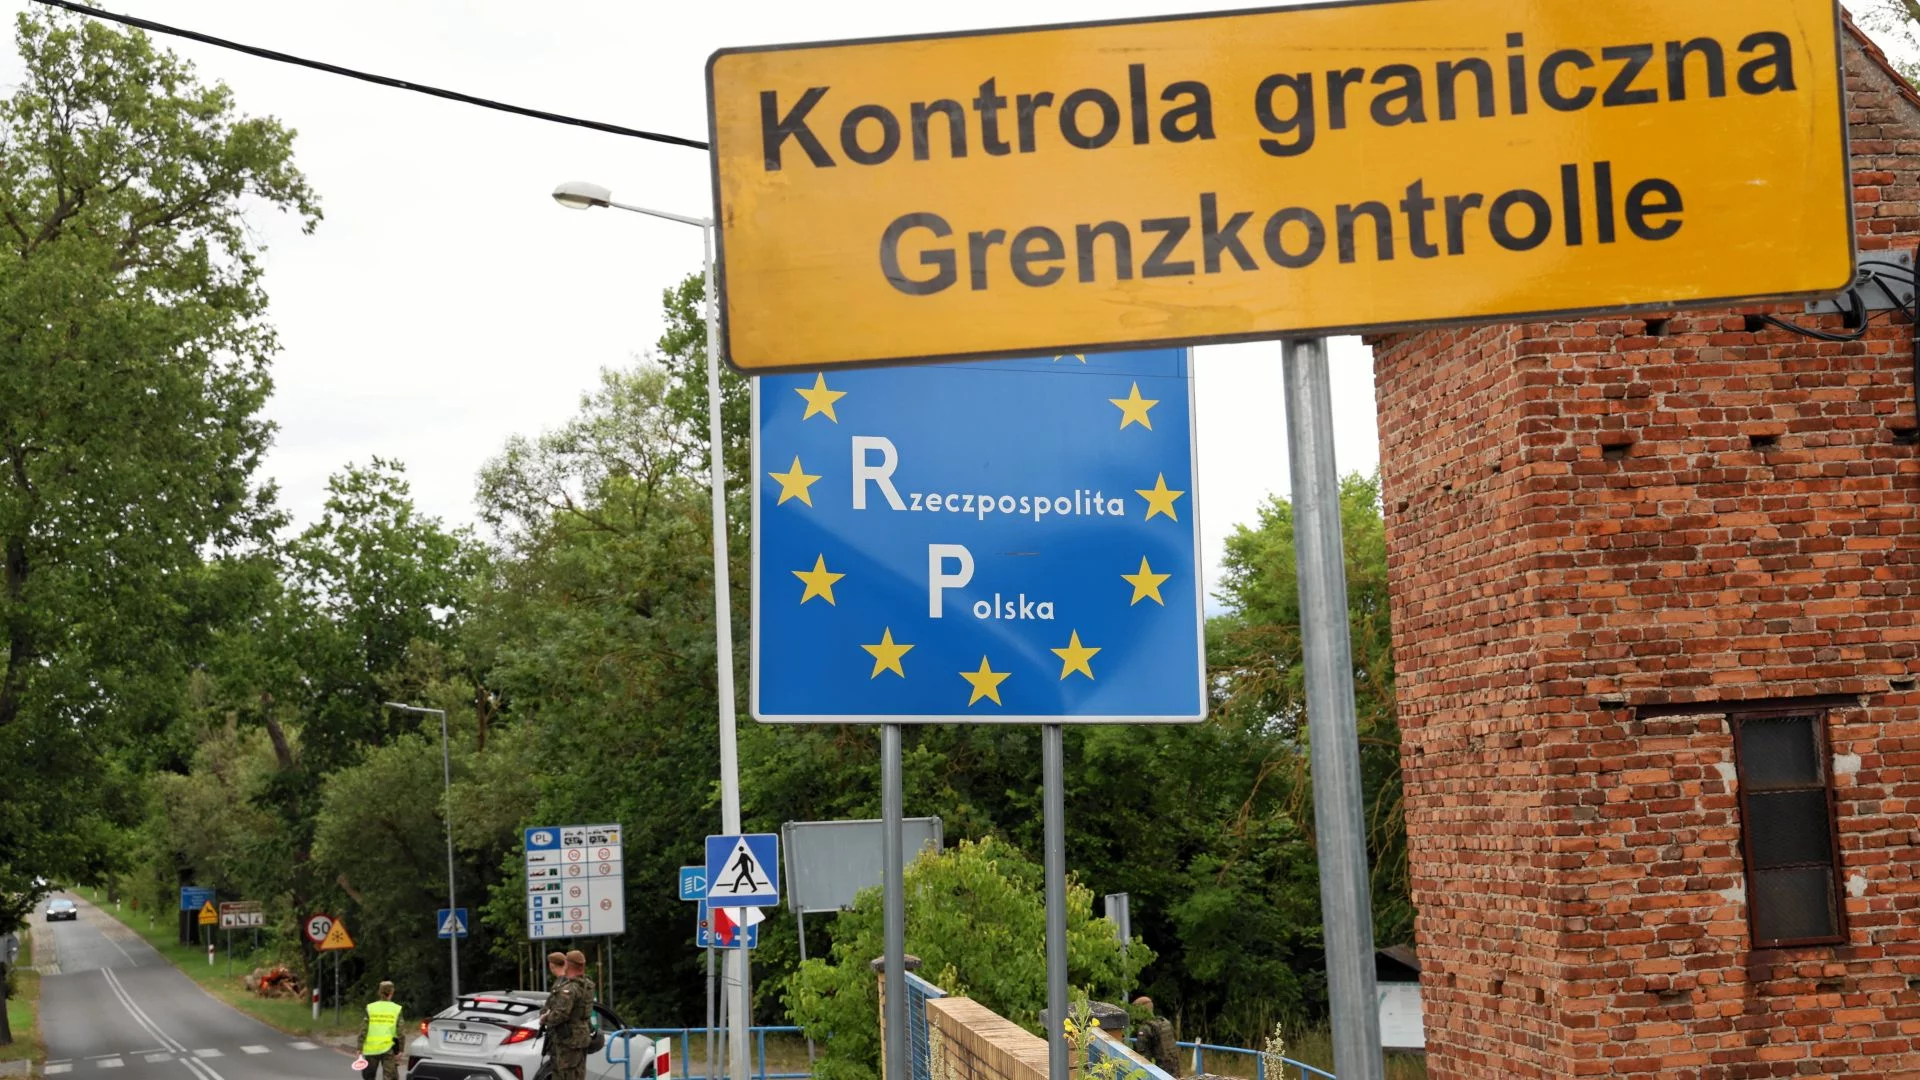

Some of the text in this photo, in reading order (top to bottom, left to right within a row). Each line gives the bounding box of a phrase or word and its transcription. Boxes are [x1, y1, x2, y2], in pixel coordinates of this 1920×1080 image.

[759, 30, 1798, 172] Kontrola graniczna
[880, 159, 1685, 296] Grenzkontrolle
[851, 435, 1125, 522] Rzeczpospolita
[928, 543, 1054, 620] Polska
[535, 834, 549, 843] PL
[312, 921, 330, 935] 50
[702, 930, 722, 940] 20
